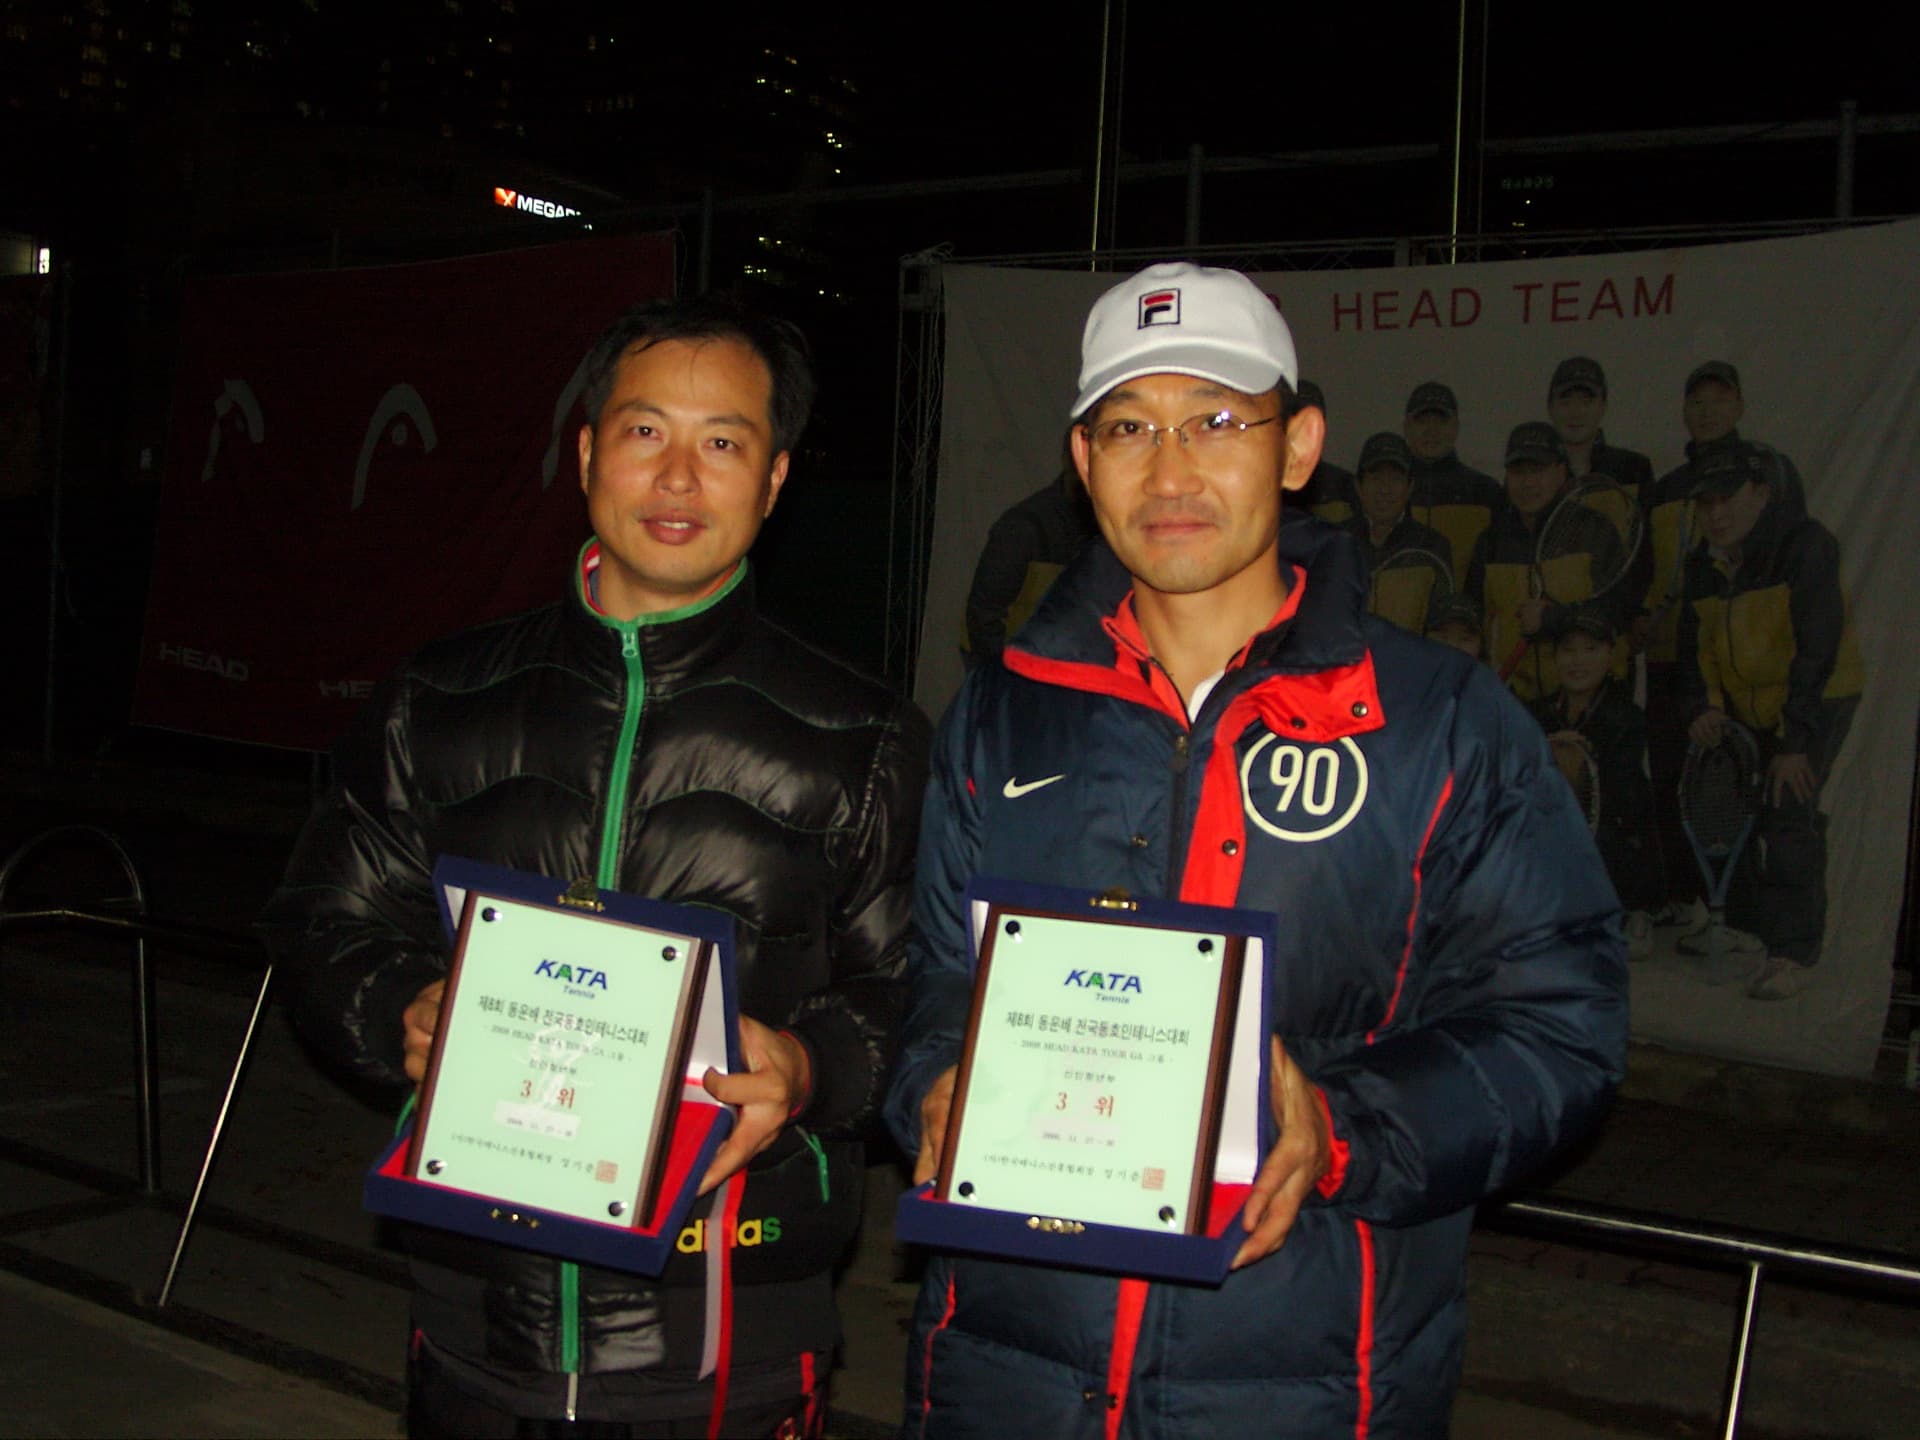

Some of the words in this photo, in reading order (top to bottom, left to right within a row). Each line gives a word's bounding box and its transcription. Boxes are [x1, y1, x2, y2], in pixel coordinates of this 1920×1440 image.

[1332, 287, 1482, 331] HEAD
[1513, 274, 1675, 323] TEAM
[158, 642, 250, 682] HEAD
[1269, 744, 1340, 816] 90
[534, 959, 608, 990] KATA
[1064, 969, 1142, 993] KATA
[1095, 993, 1130, 1004] Tennis
[1006, 1011, 1034, 1029] 제8회
[1075, 1018, 1190, 1046] 전국동호인테니스대회
[520, 1080, 532, 1098] 3
[557, 1087, 575, 1109] 위
[1056, 1091, 1068, 1111] 3
[1094, 1095, 1114, 1118] 위
